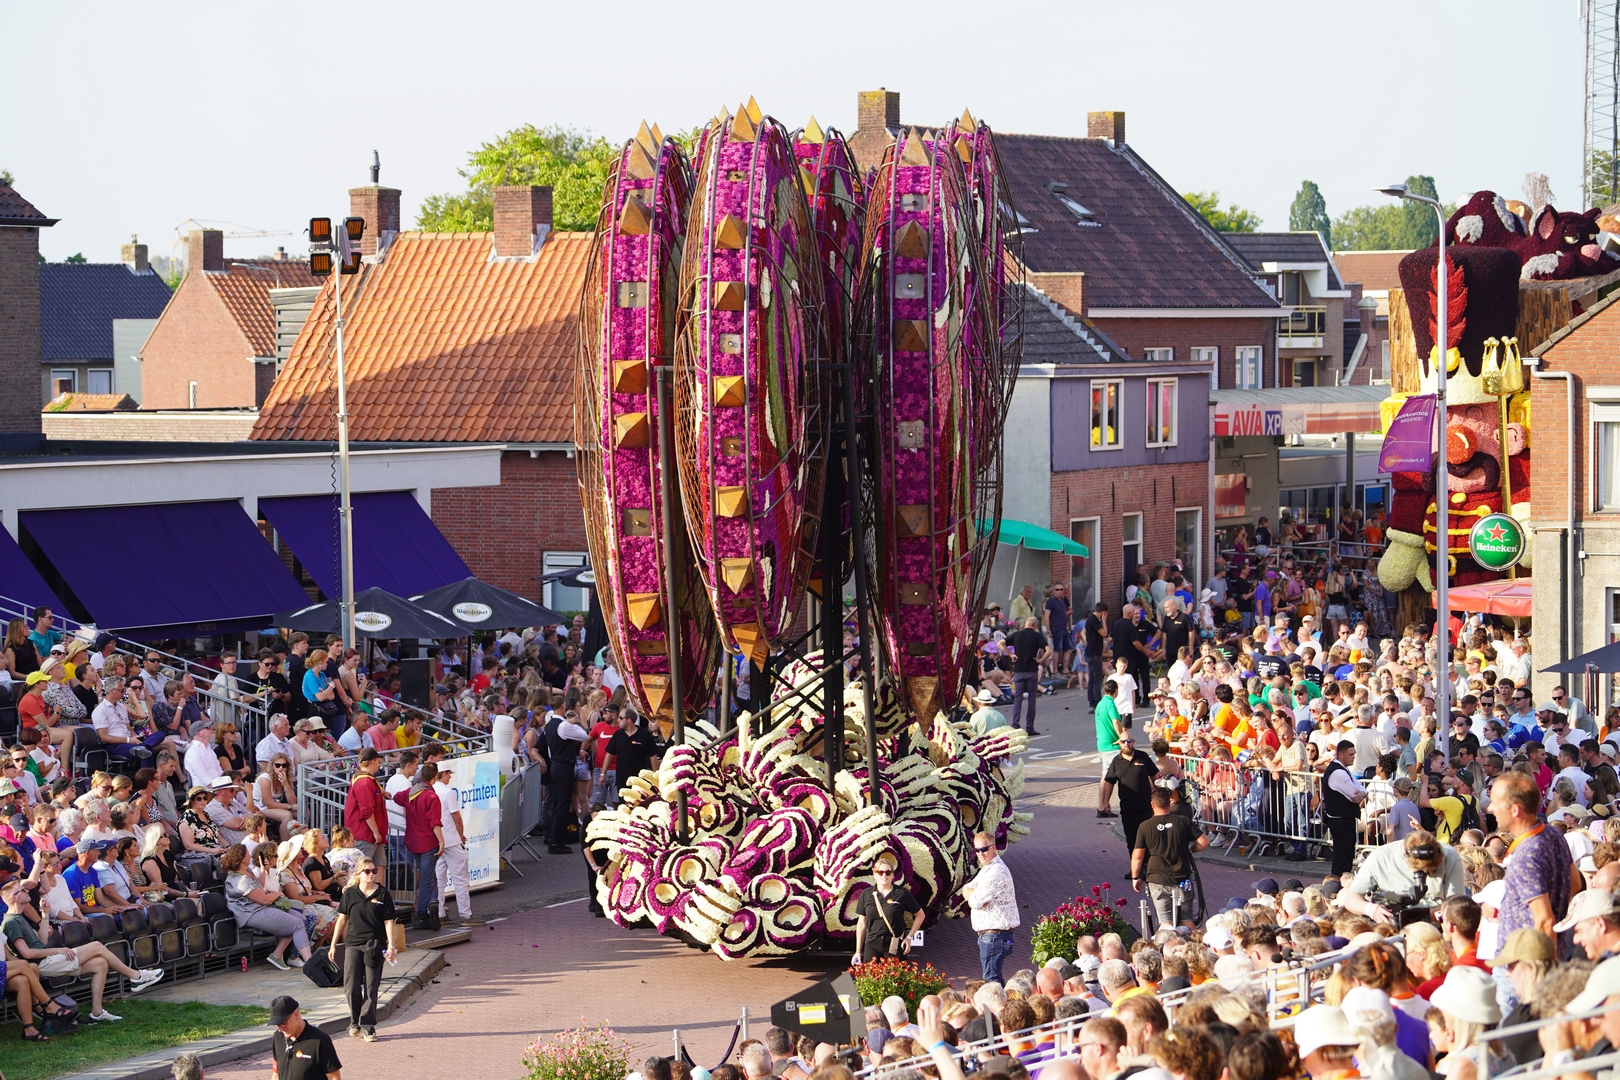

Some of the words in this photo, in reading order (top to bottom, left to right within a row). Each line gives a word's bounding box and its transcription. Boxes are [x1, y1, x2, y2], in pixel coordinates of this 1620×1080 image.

[1476, 542, 1517, 552] Heineken
[456, 608, 488, 616] Warsteiner
[461, 784, 497, 809] printen
[469, 830, 494, 844] doorlooptijd
